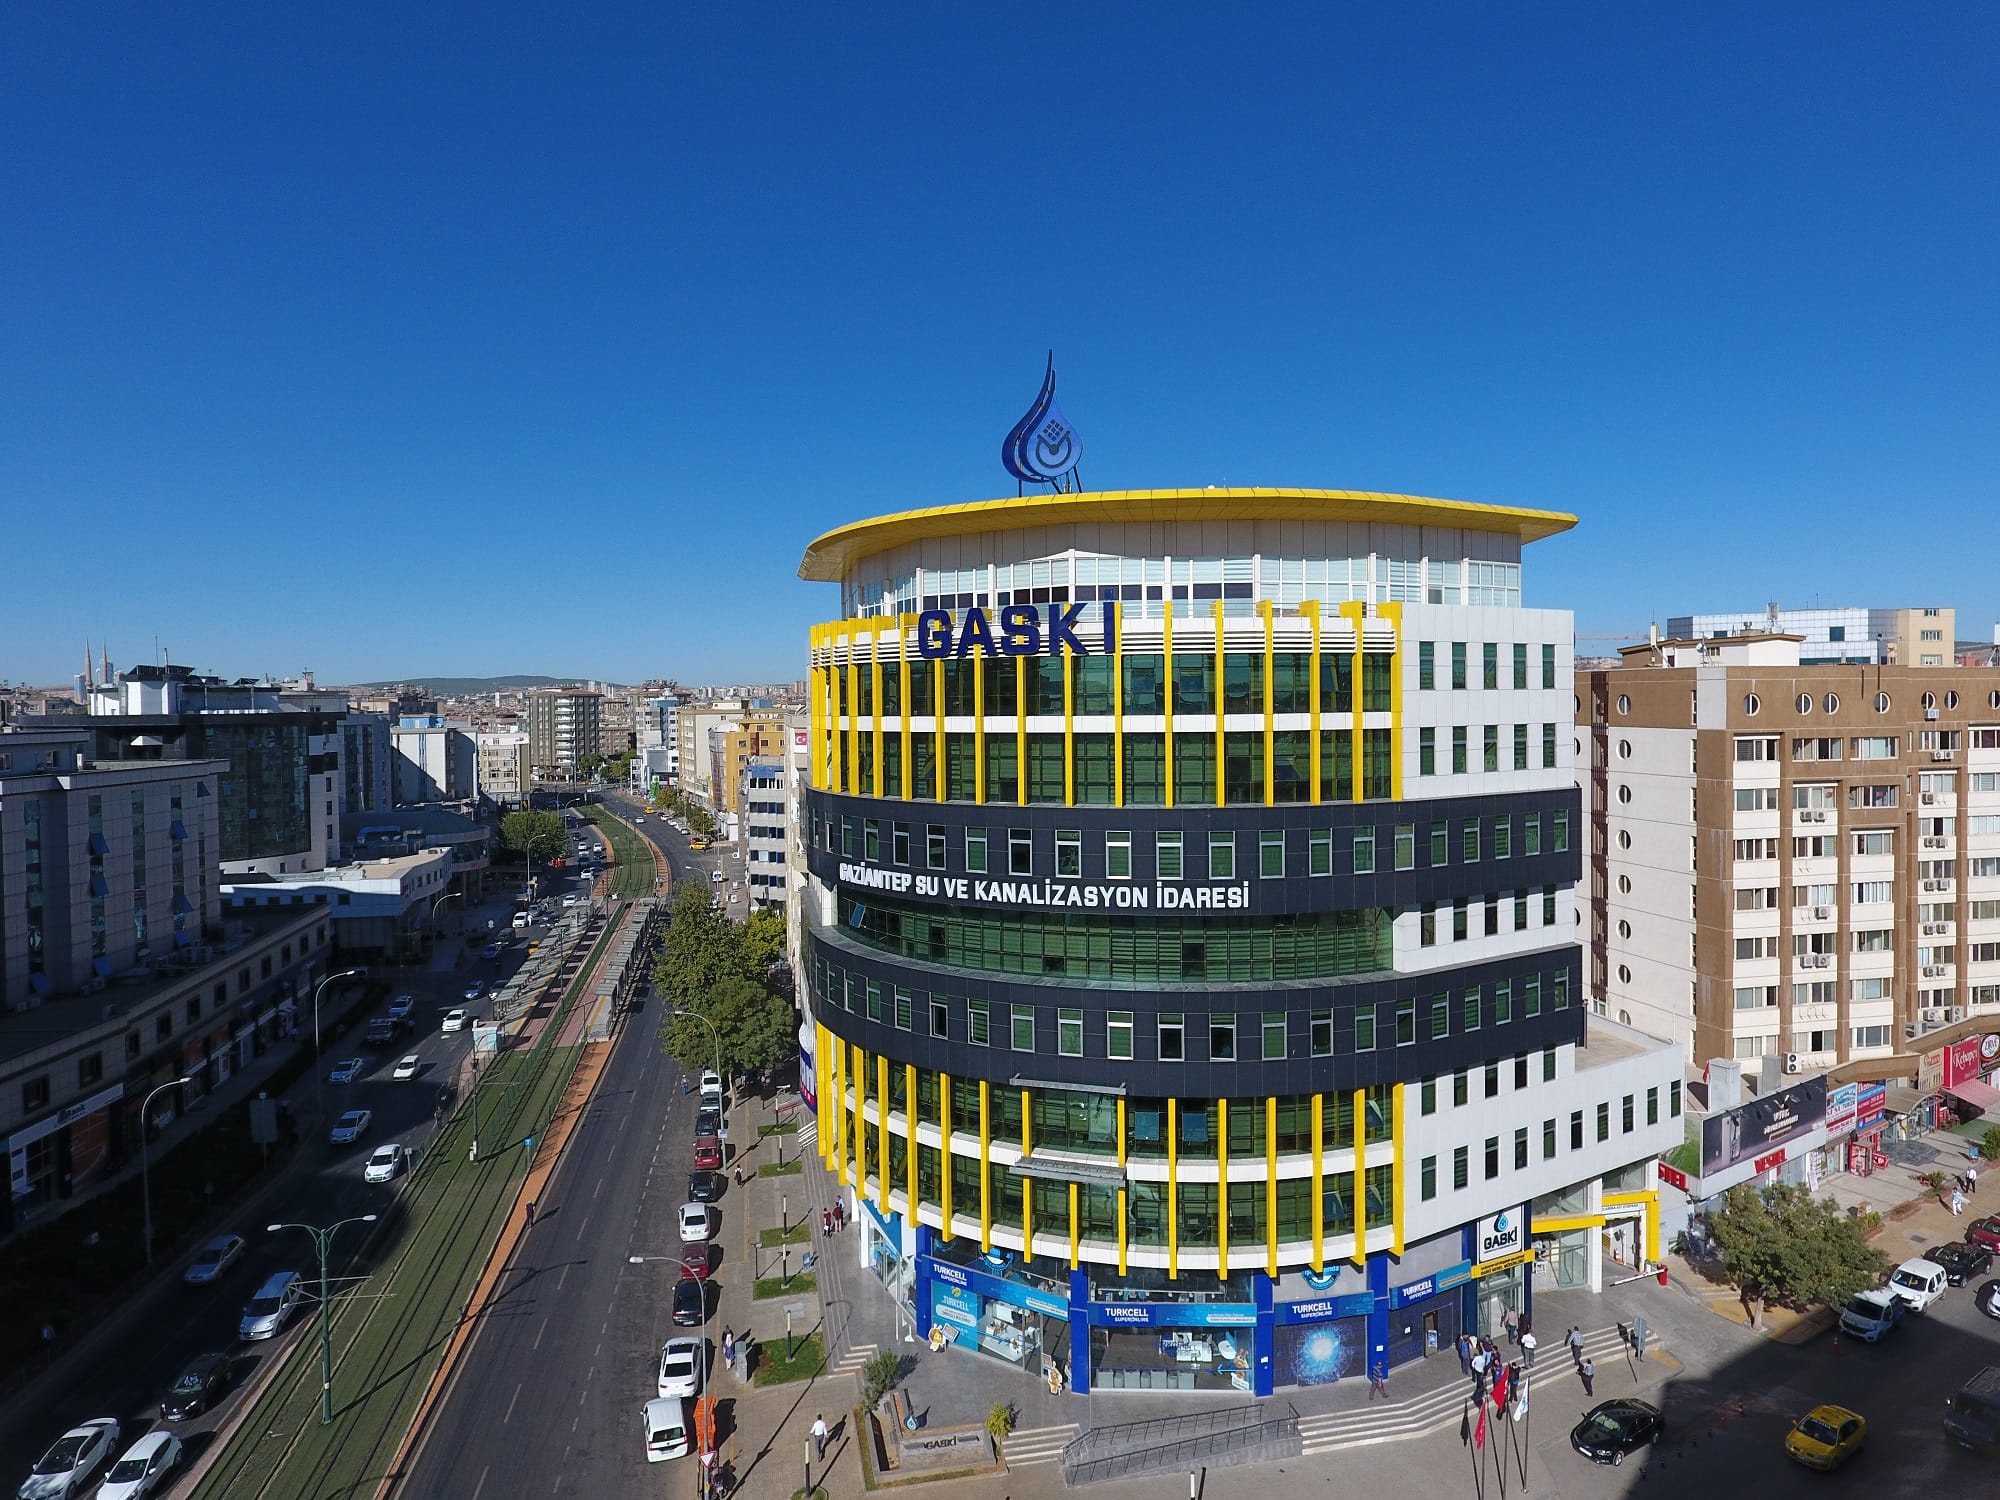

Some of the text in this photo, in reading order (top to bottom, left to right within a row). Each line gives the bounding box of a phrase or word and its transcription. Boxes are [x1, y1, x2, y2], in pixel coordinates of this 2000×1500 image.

[918, 588, 1115, 660] GASKİ
[839, 861, 1249, 909] GAZİANTEP SU VE KANALİZASYON İDARESİ
[933, 1264, 968, 1281] TURKCELL
[1401, 1279, 1433, 1297] TURKCELL
[1105, 1307, 1149, 1317] TURKCELL
[1292, 1301, 1333, 1315] TURKCELL
